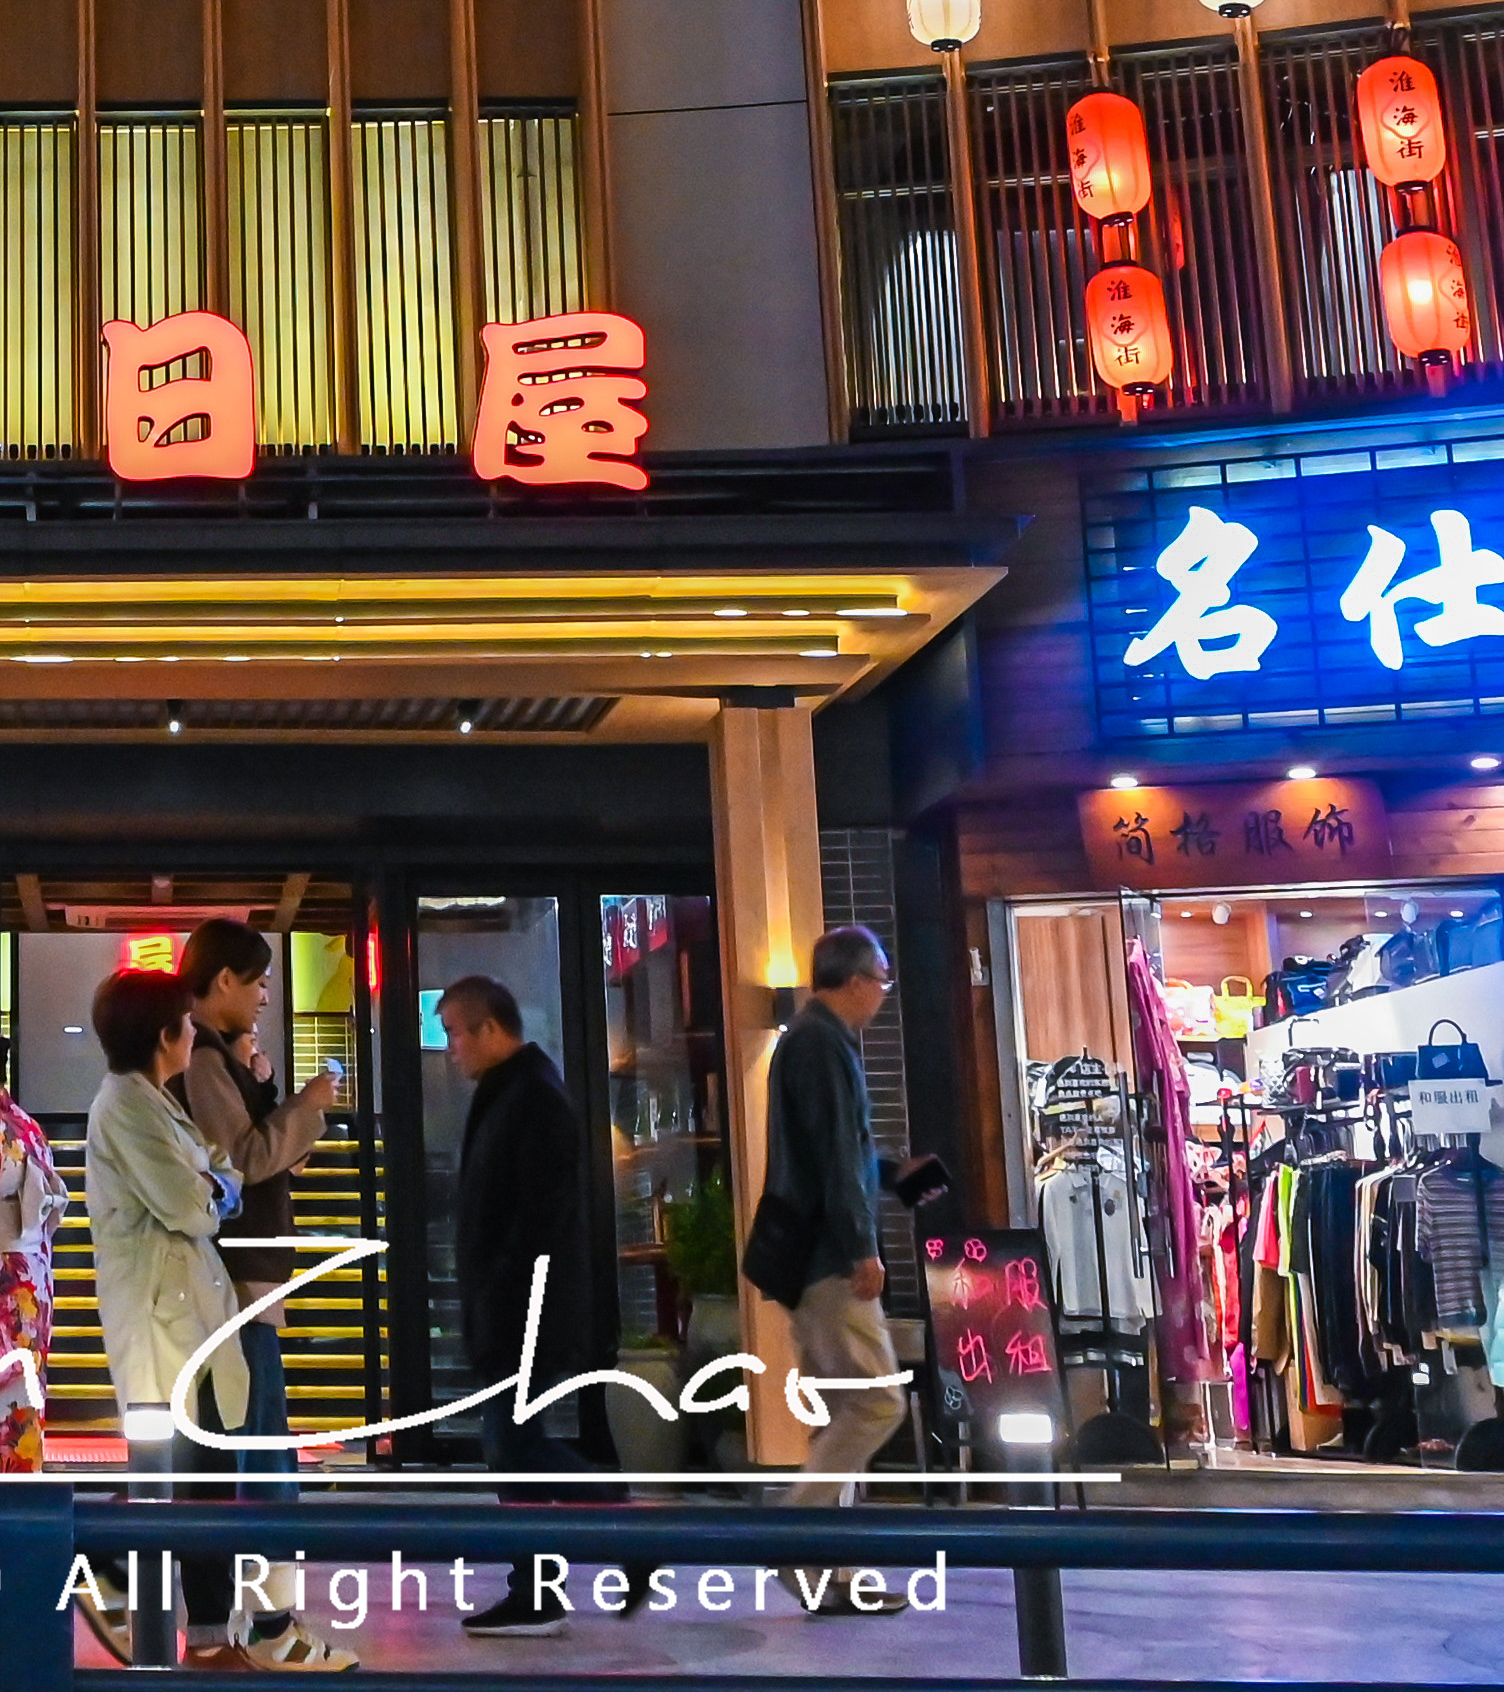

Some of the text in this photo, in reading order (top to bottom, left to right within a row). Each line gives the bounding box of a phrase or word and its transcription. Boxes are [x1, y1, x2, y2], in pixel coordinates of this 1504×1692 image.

[1388, 71, 1424, 159] 淮海街
[1107, 280, 1141, 366] 淮海街
[1113, 803, 1355, 865] 简格服饰
[1419, 1089, 1479, 1105] 和服出租
[957, 1328, 1052, 1385] 出租
